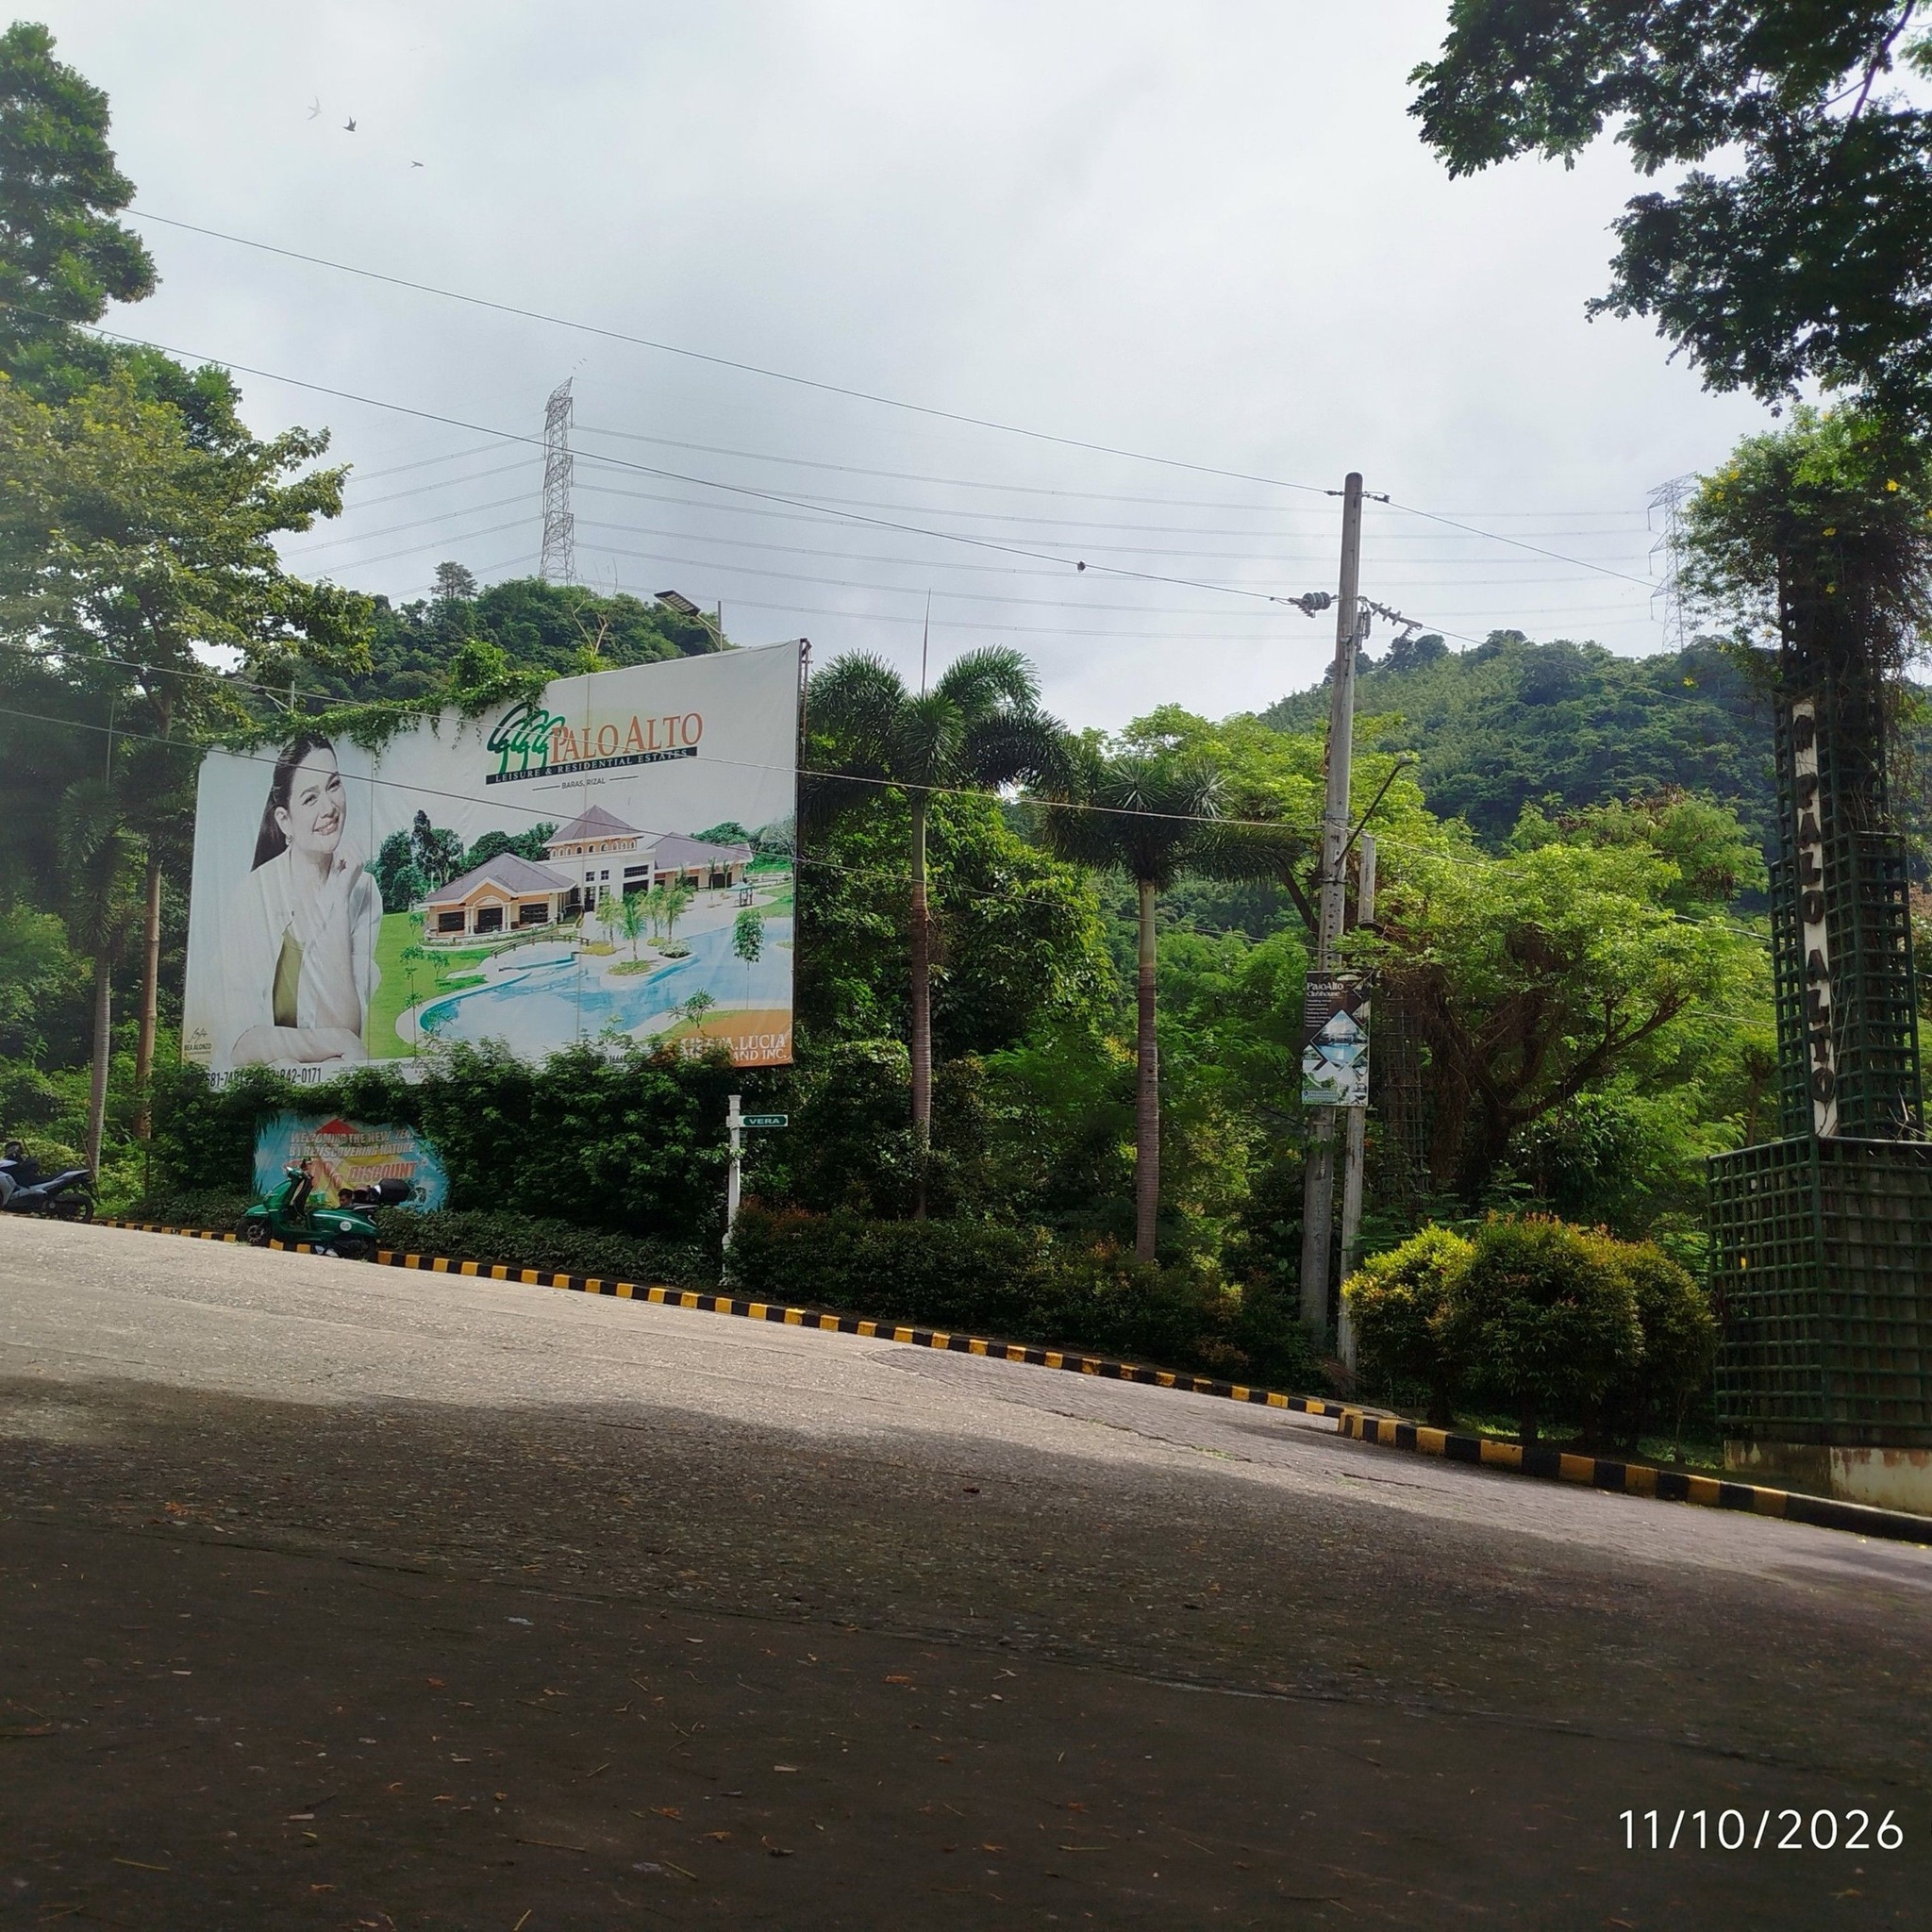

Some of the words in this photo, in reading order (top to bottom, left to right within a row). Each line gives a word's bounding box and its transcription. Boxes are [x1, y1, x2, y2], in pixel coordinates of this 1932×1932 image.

[551, 724, 619, 764] PALO
[623, 712, 703, 755] ALTO
[495, 769, 541, 783] LEISURE
[544, 767, 553, 775] &
[558, 758, 633, 774] RESIDENTIAL
[638, 749, 688, 762] ESTATES
[586, 777, 606, 787] RIZAL
[1806, 948, 1836, 1104] ALTO
[732, 1050, 759, 1061] AND
[762, 1048, 787, 1060] INC.
[291, 1131, 347, 1143] WELCOMING
[349, 1133, 366, 1143] THE
[368, 1130, 391, 1142] NEW
[380, 1141, 416, 1156] NATURE
[348, 1161, 417, 1180] DISCOUNT
